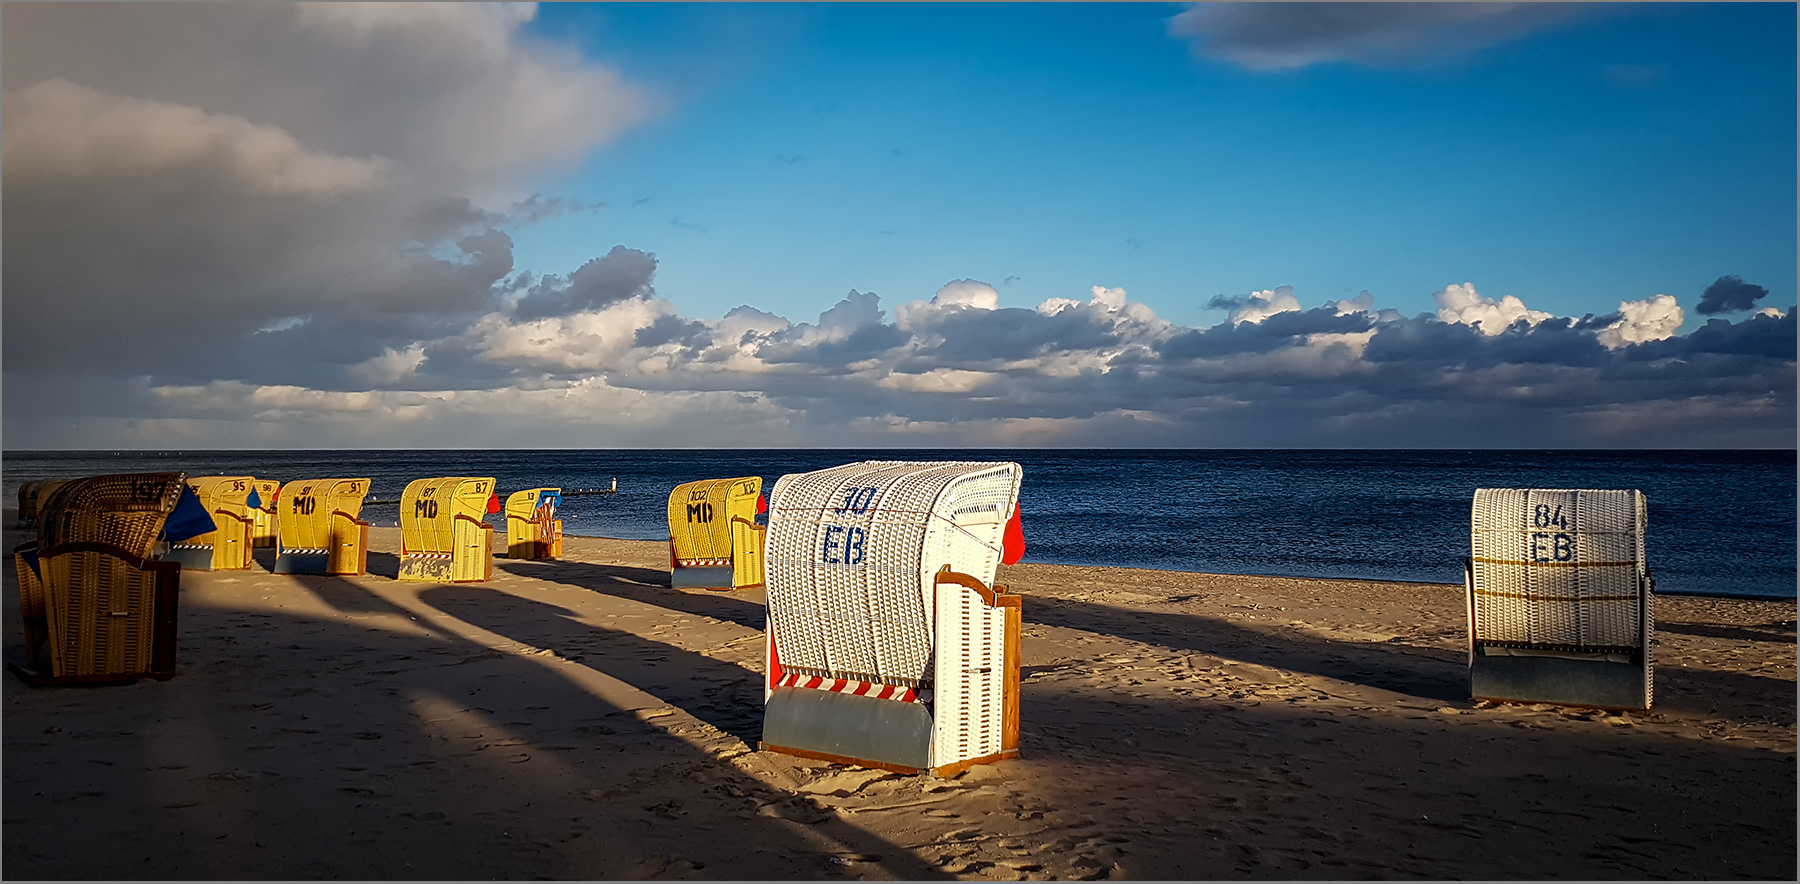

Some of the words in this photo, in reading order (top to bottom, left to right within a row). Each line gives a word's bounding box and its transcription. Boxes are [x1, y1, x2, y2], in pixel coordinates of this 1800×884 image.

[233, 481, 246, 492] 95
[262, 484, 272, 492] 98
[301, 486, 312, 495] 91
[350, 482, 361, 493] 91
[475, 482, 488, 493] 87
[743, 482, 756, 496] 102
[423, 487, 436, 498] 87
[527, 492, 535, 501] 13
[691, 490, 707, 501] 102
[293, 496, 316, 515] MD
[415, 499, 438, 519] MD
[686, 502, 713, 524] MD
[1534, 504, 1568, 530] 84
[822, 525, 865, 565] EB
[1532, 532, 1573, 563] EB
